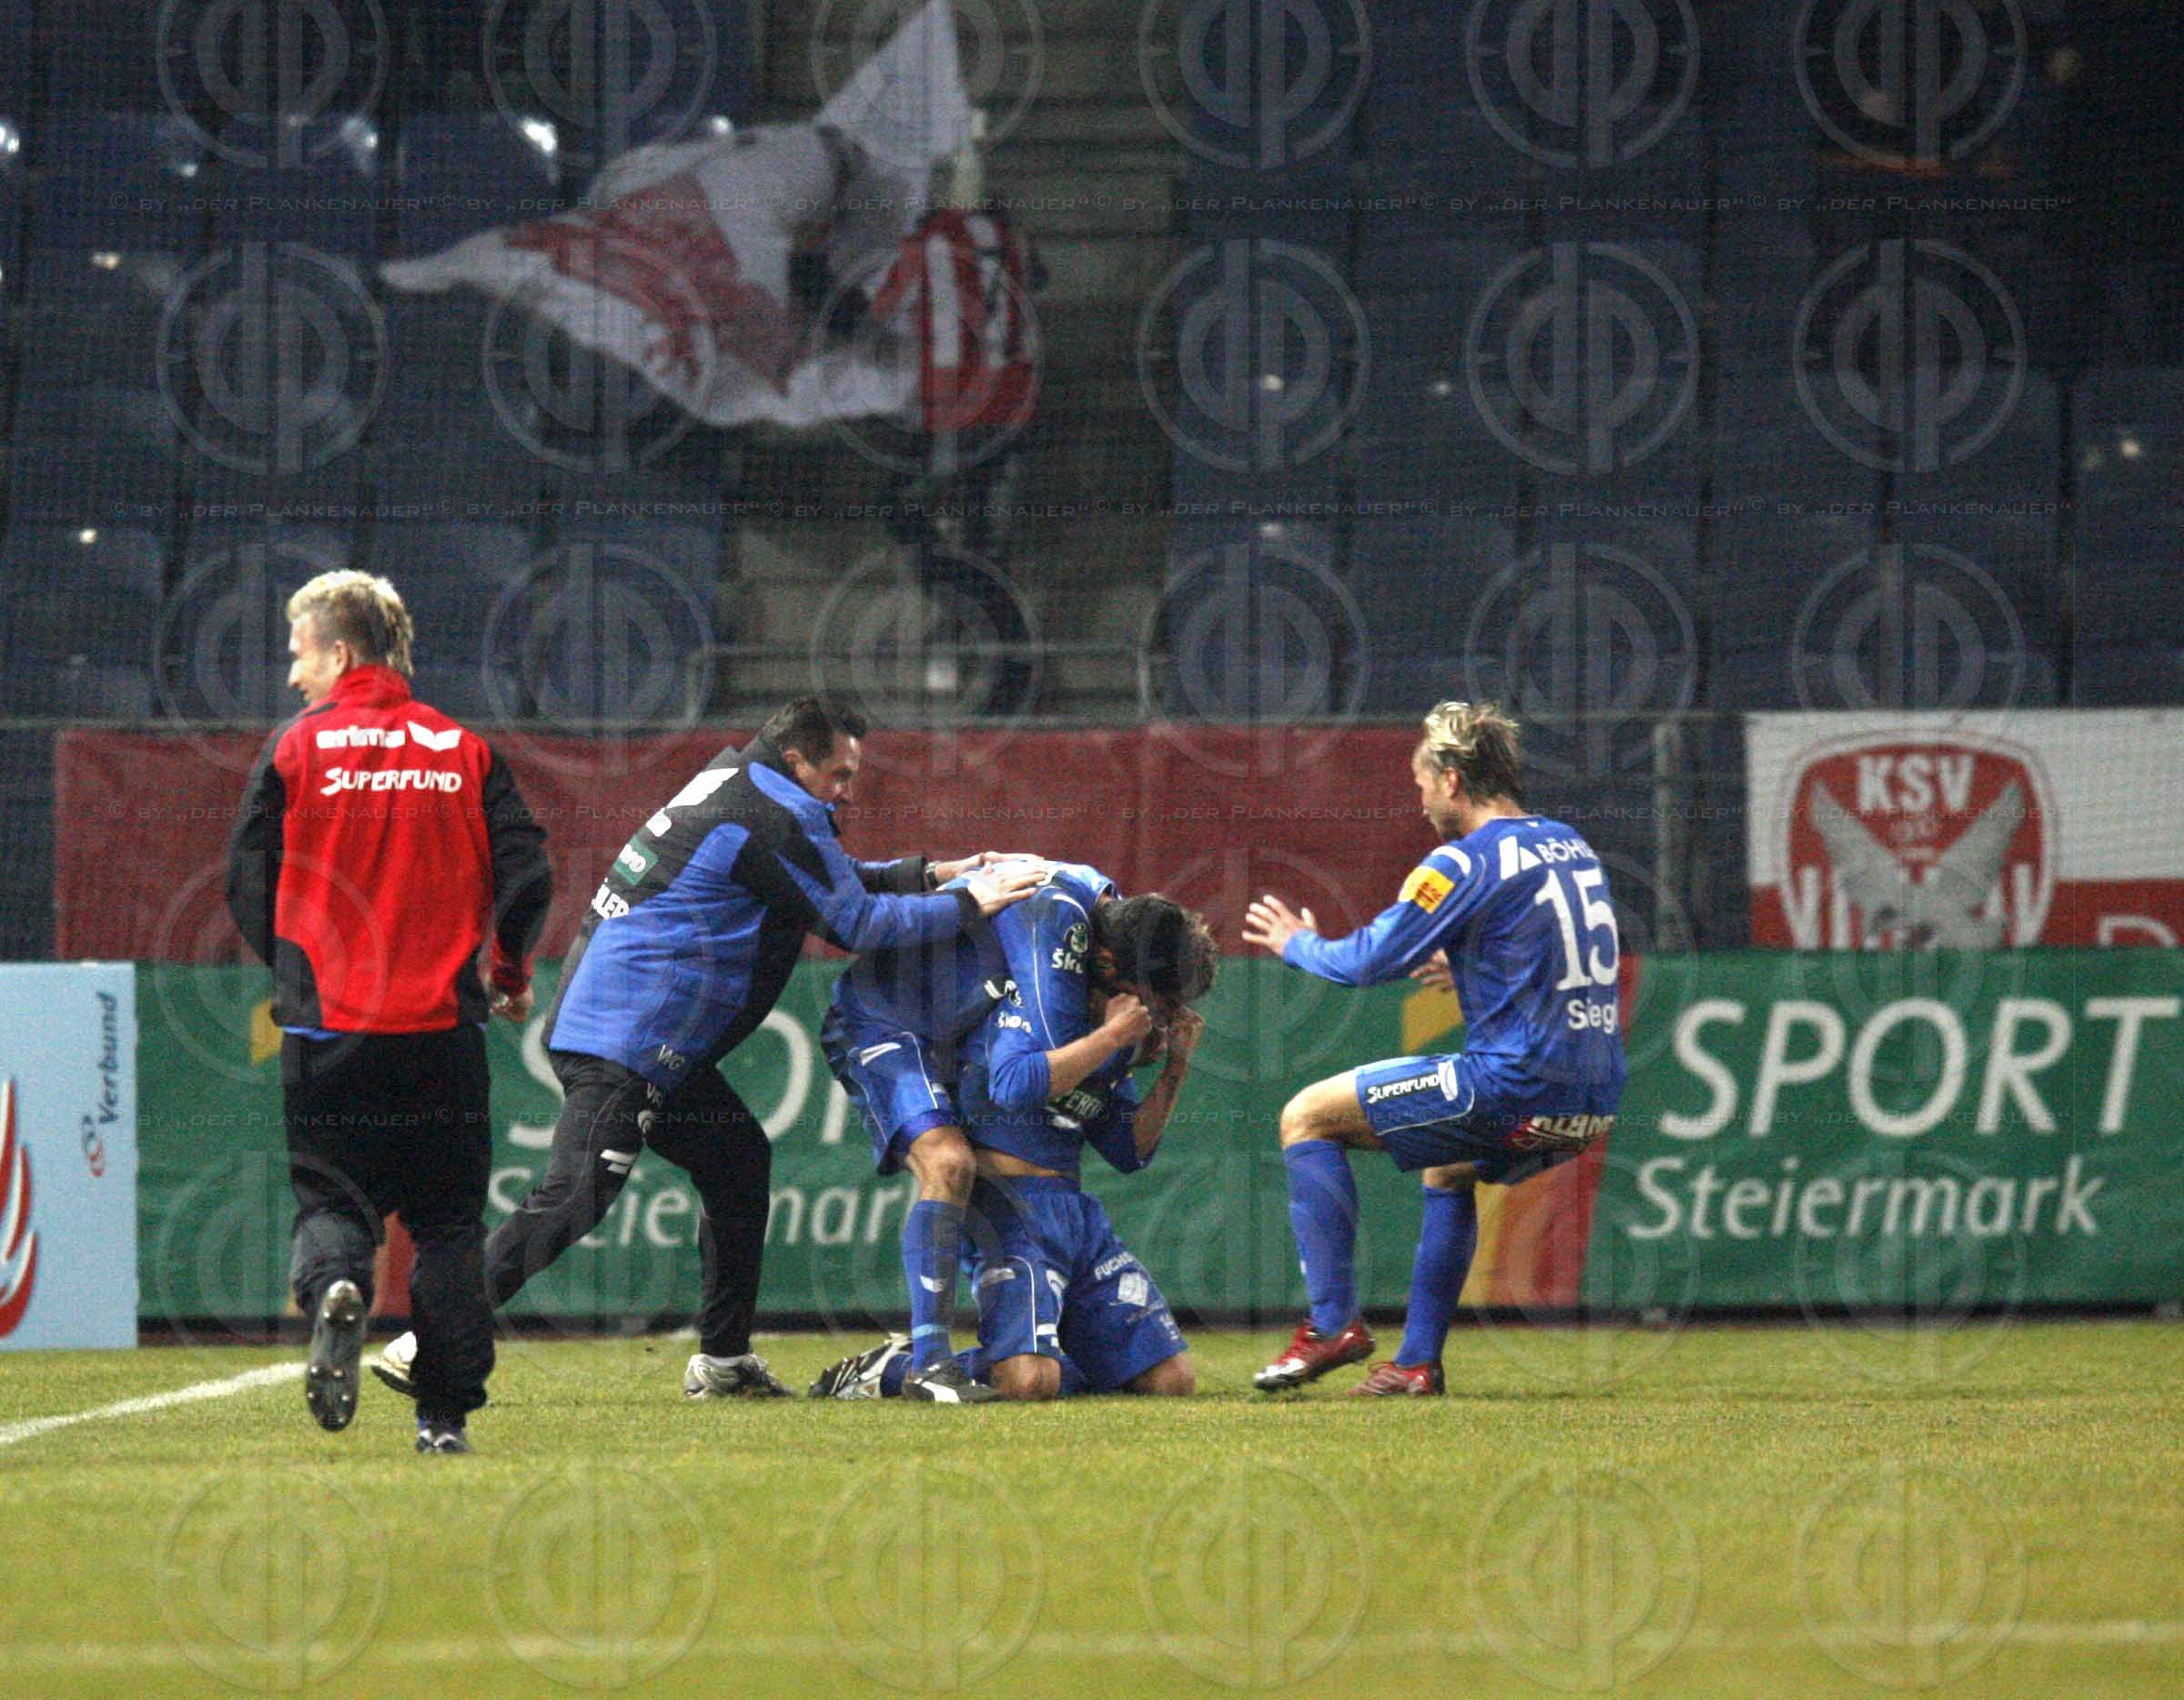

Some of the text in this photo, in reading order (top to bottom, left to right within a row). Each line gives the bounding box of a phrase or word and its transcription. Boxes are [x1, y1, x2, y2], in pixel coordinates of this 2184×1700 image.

[319, 766, 463, 796] SUPERFUND
[1855, 754, 1976, 813] KSV
[1534, 869, 1620, 991] 15
[96, 990, 119, 1125] Verbund
[1658, 996, 2181, 1138] SPORT
[1627, 1152, 2106, 1240] Steiermark
